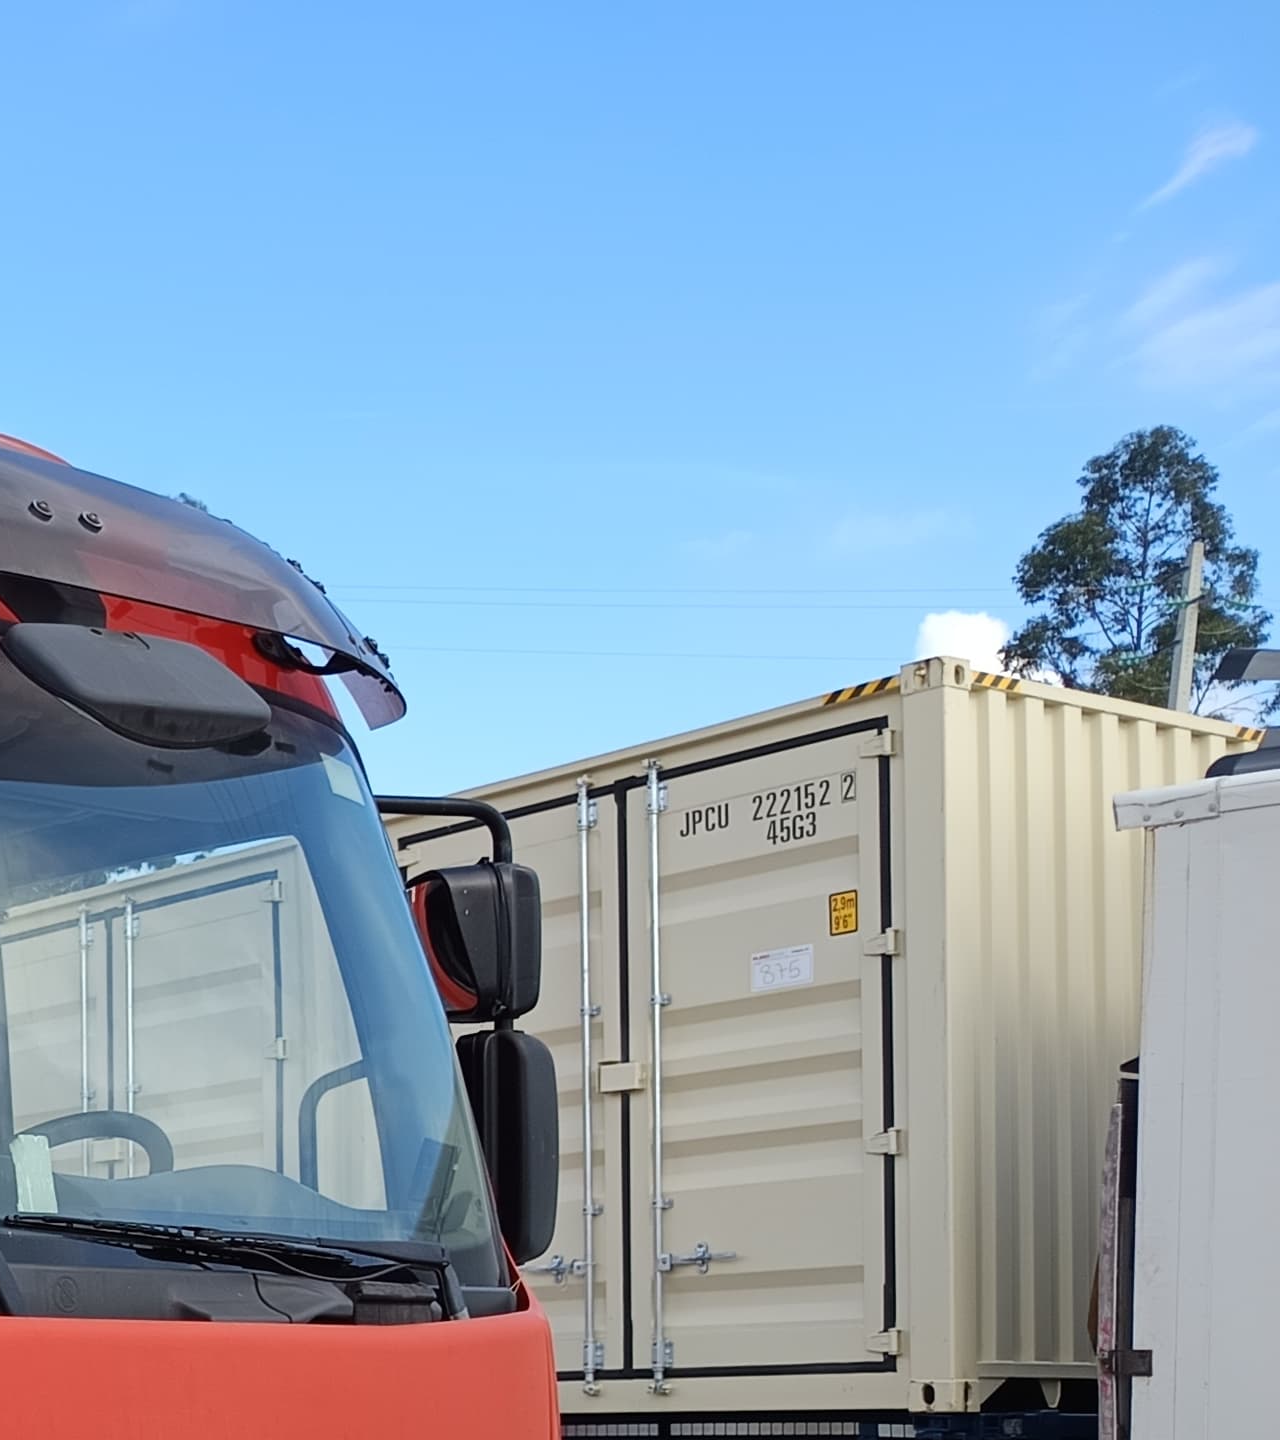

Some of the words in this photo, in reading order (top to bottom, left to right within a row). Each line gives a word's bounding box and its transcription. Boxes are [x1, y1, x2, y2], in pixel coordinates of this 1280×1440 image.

[679, 802, 730, 838] JPCU
[751, 779, 831, 822] 222152
[842, 773, 855, 801] 2
[766, 811, 817, 846] 45G3
